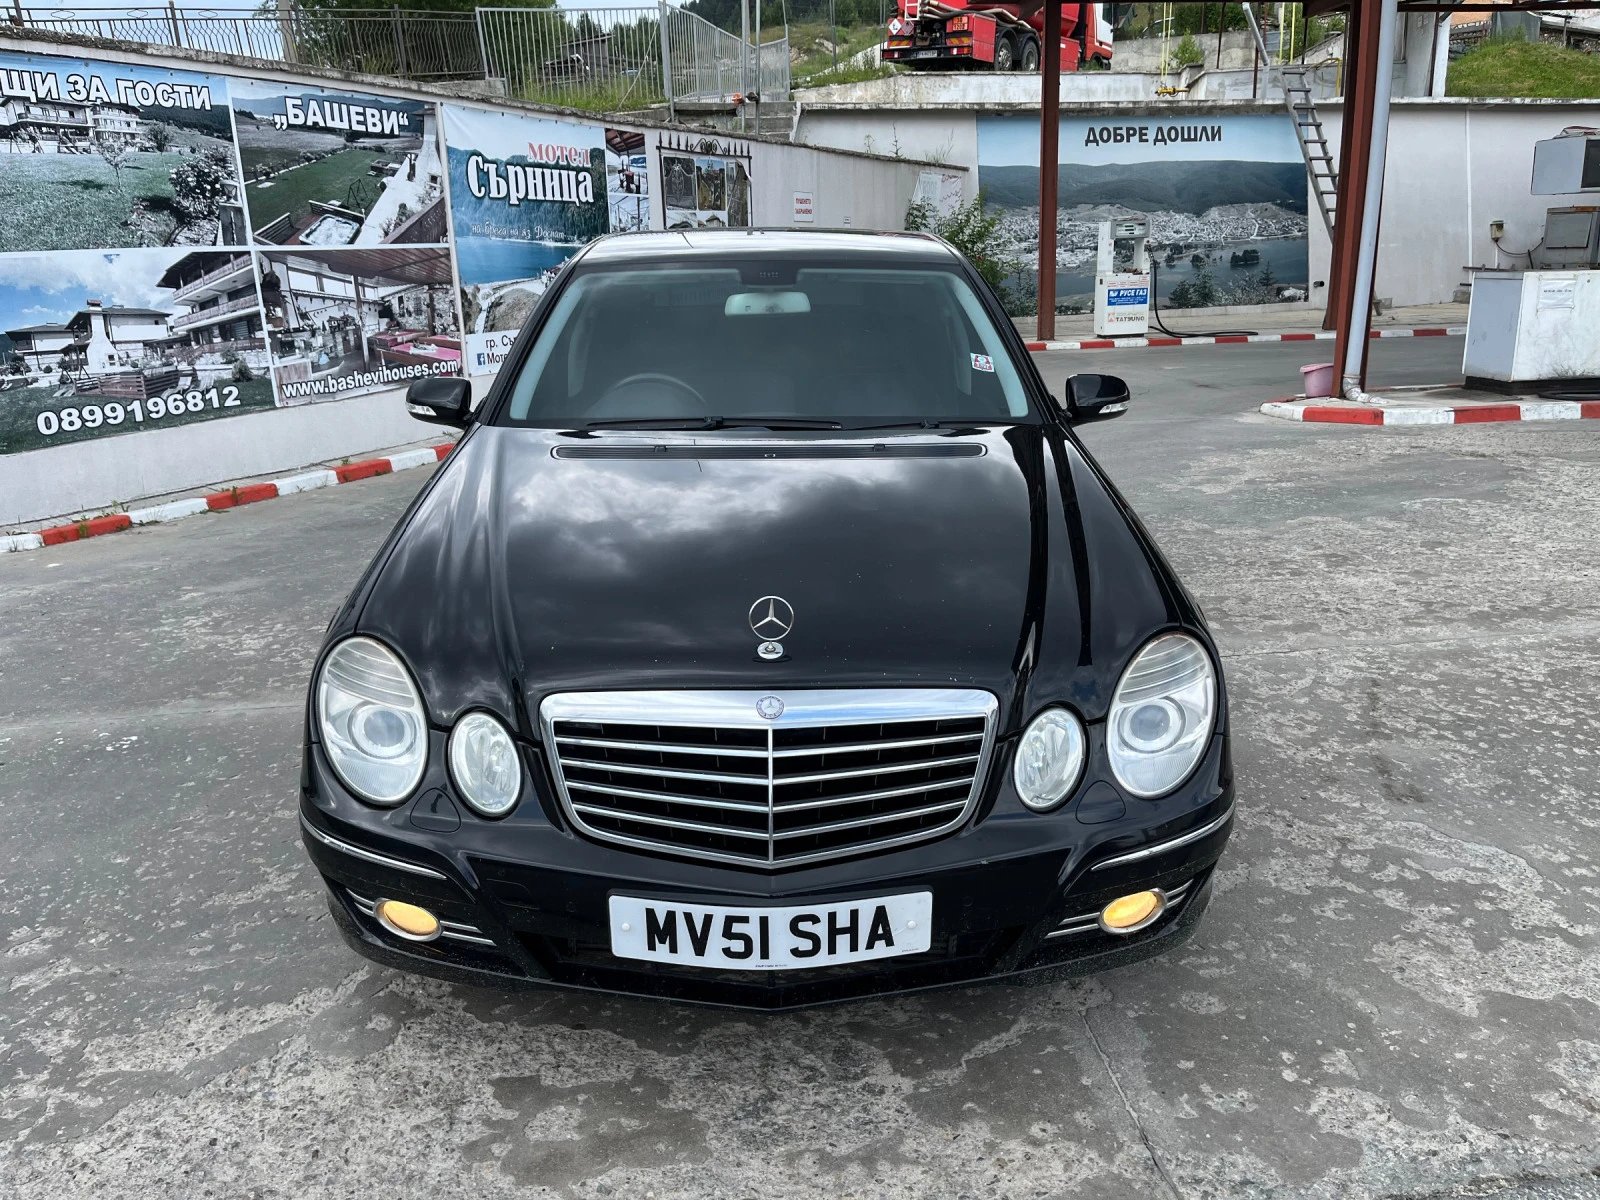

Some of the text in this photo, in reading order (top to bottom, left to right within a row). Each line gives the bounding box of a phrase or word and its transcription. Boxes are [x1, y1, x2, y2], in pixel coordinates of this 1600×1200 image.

[66, 73, 112, 103] ЗА
[116, 78, 212, 111] ГОСТИ
[1084, 125, 1222, 146] ДОБРЕ ДОШЛИ
[467, 155, 594, 206] Сърница
[282, 359, 459, 398] www.bashevihouses.com
[36, 385, 241, 436] 0899196812
[644, 904, 895, 960] MV51 SHA
